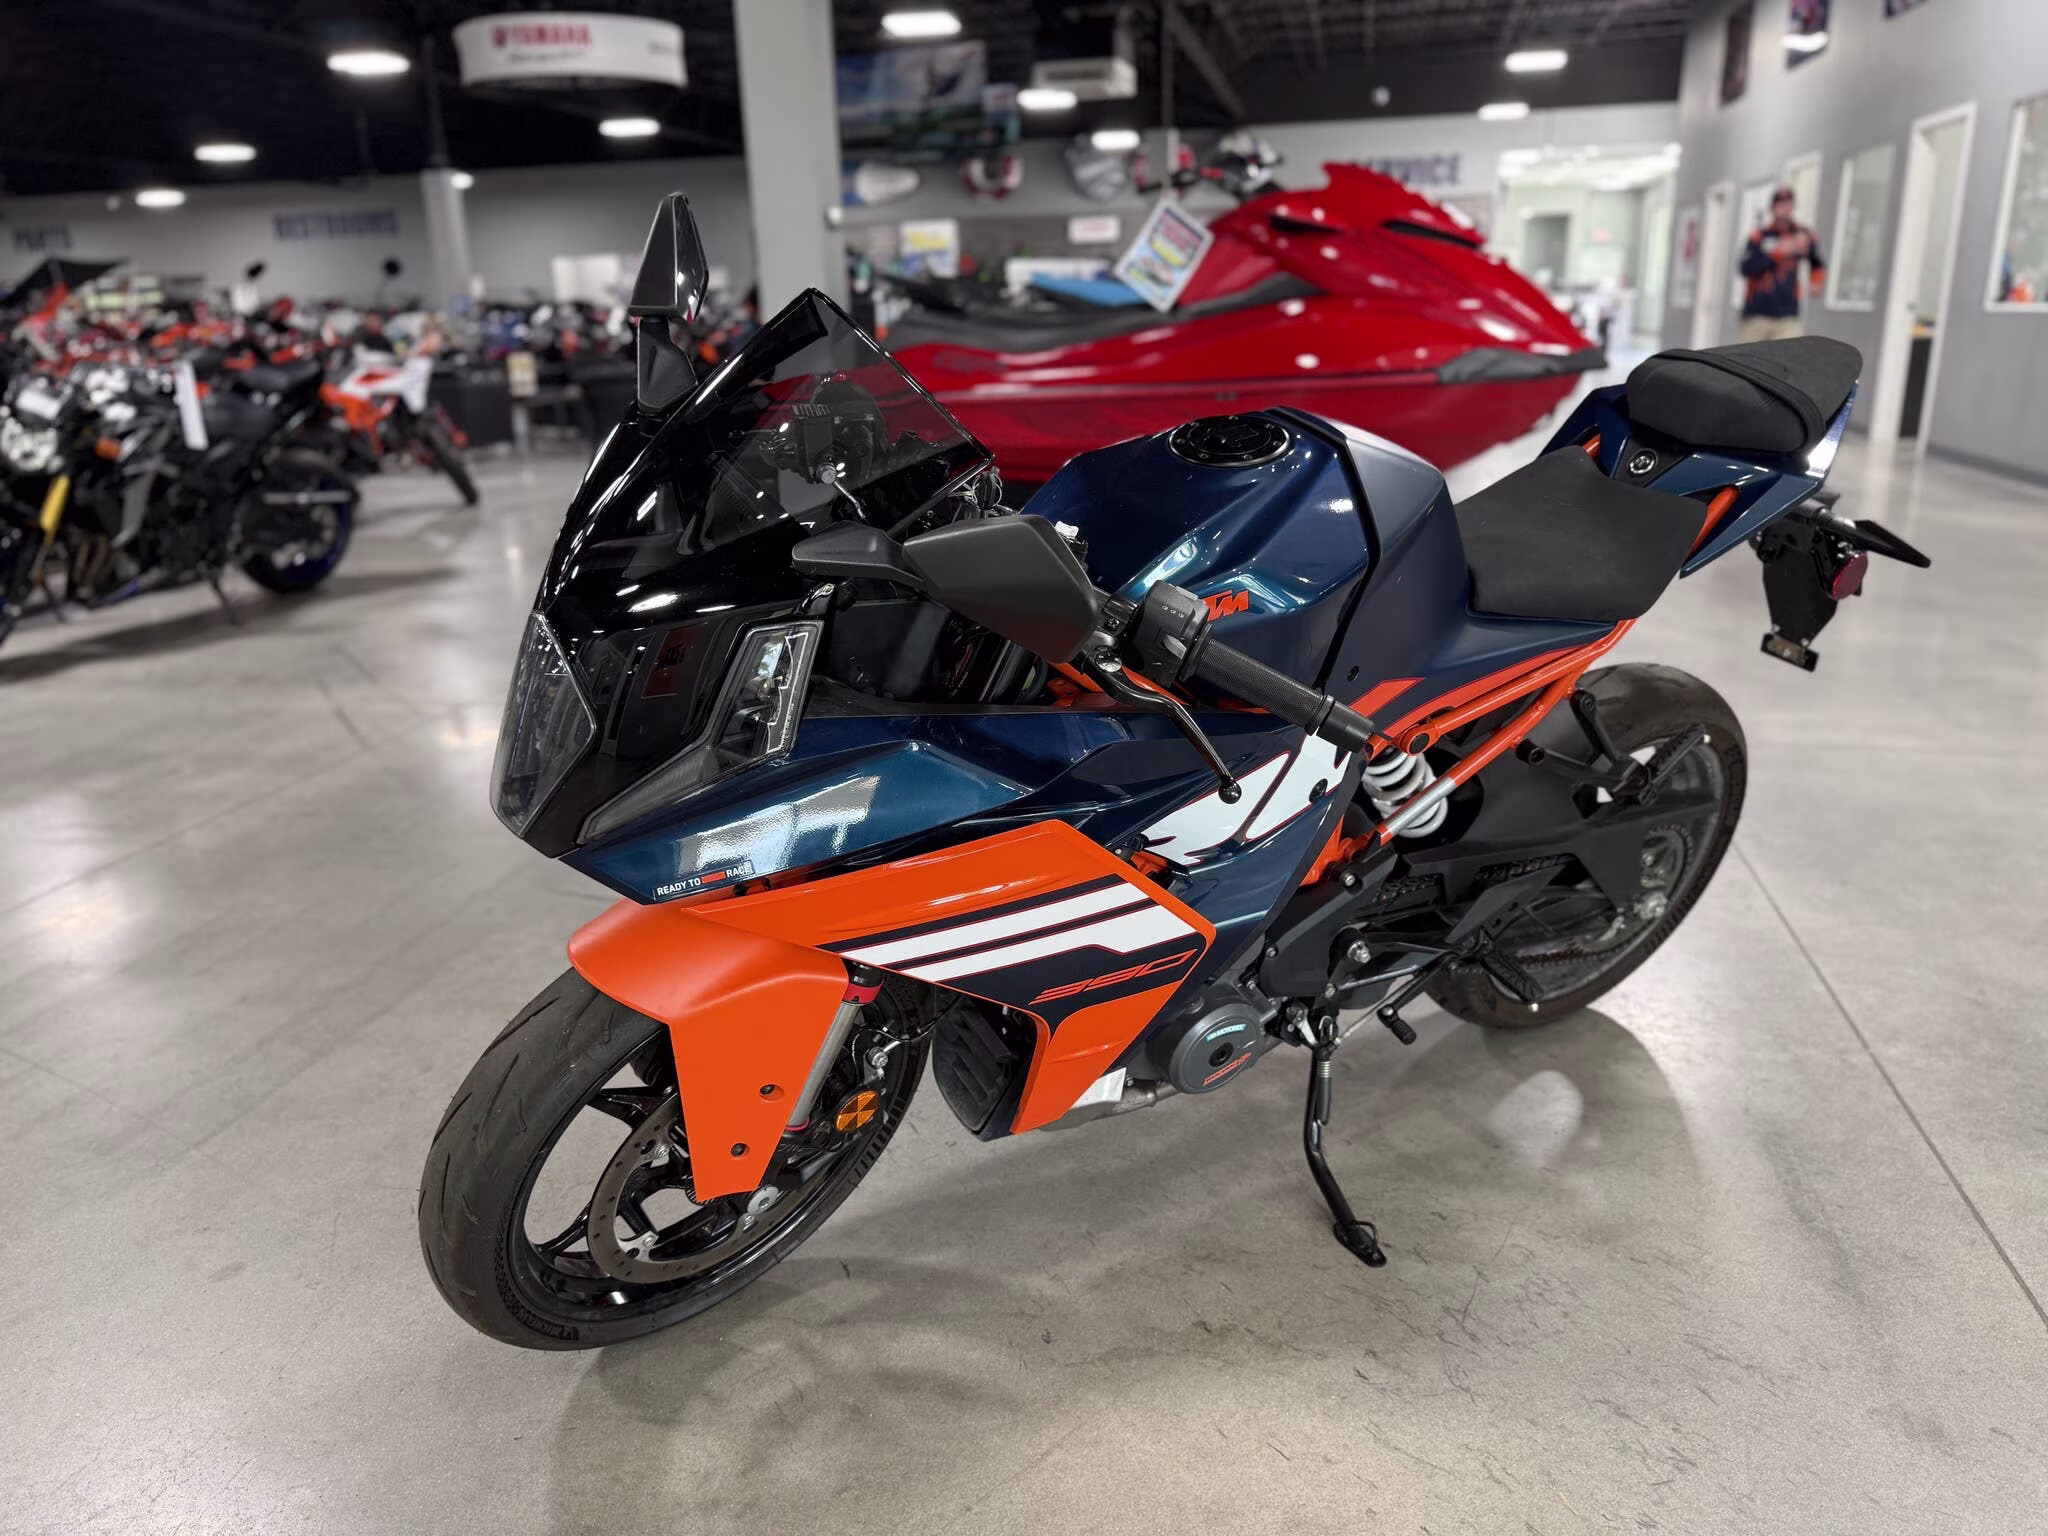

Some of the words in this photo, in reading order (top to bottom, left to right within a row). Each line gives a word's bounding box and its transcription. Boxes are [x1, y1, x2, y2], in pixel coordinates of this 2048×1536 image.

[507, 23, 593, 47] YAMAHA
[1202, 588, 1249, 622] TM
[656, 880, 687, 896] READY
[688, 877, 701, 888] TO
[725, 862, 753, 878] RACE
[1027, 949, 1198, 1006] 390
